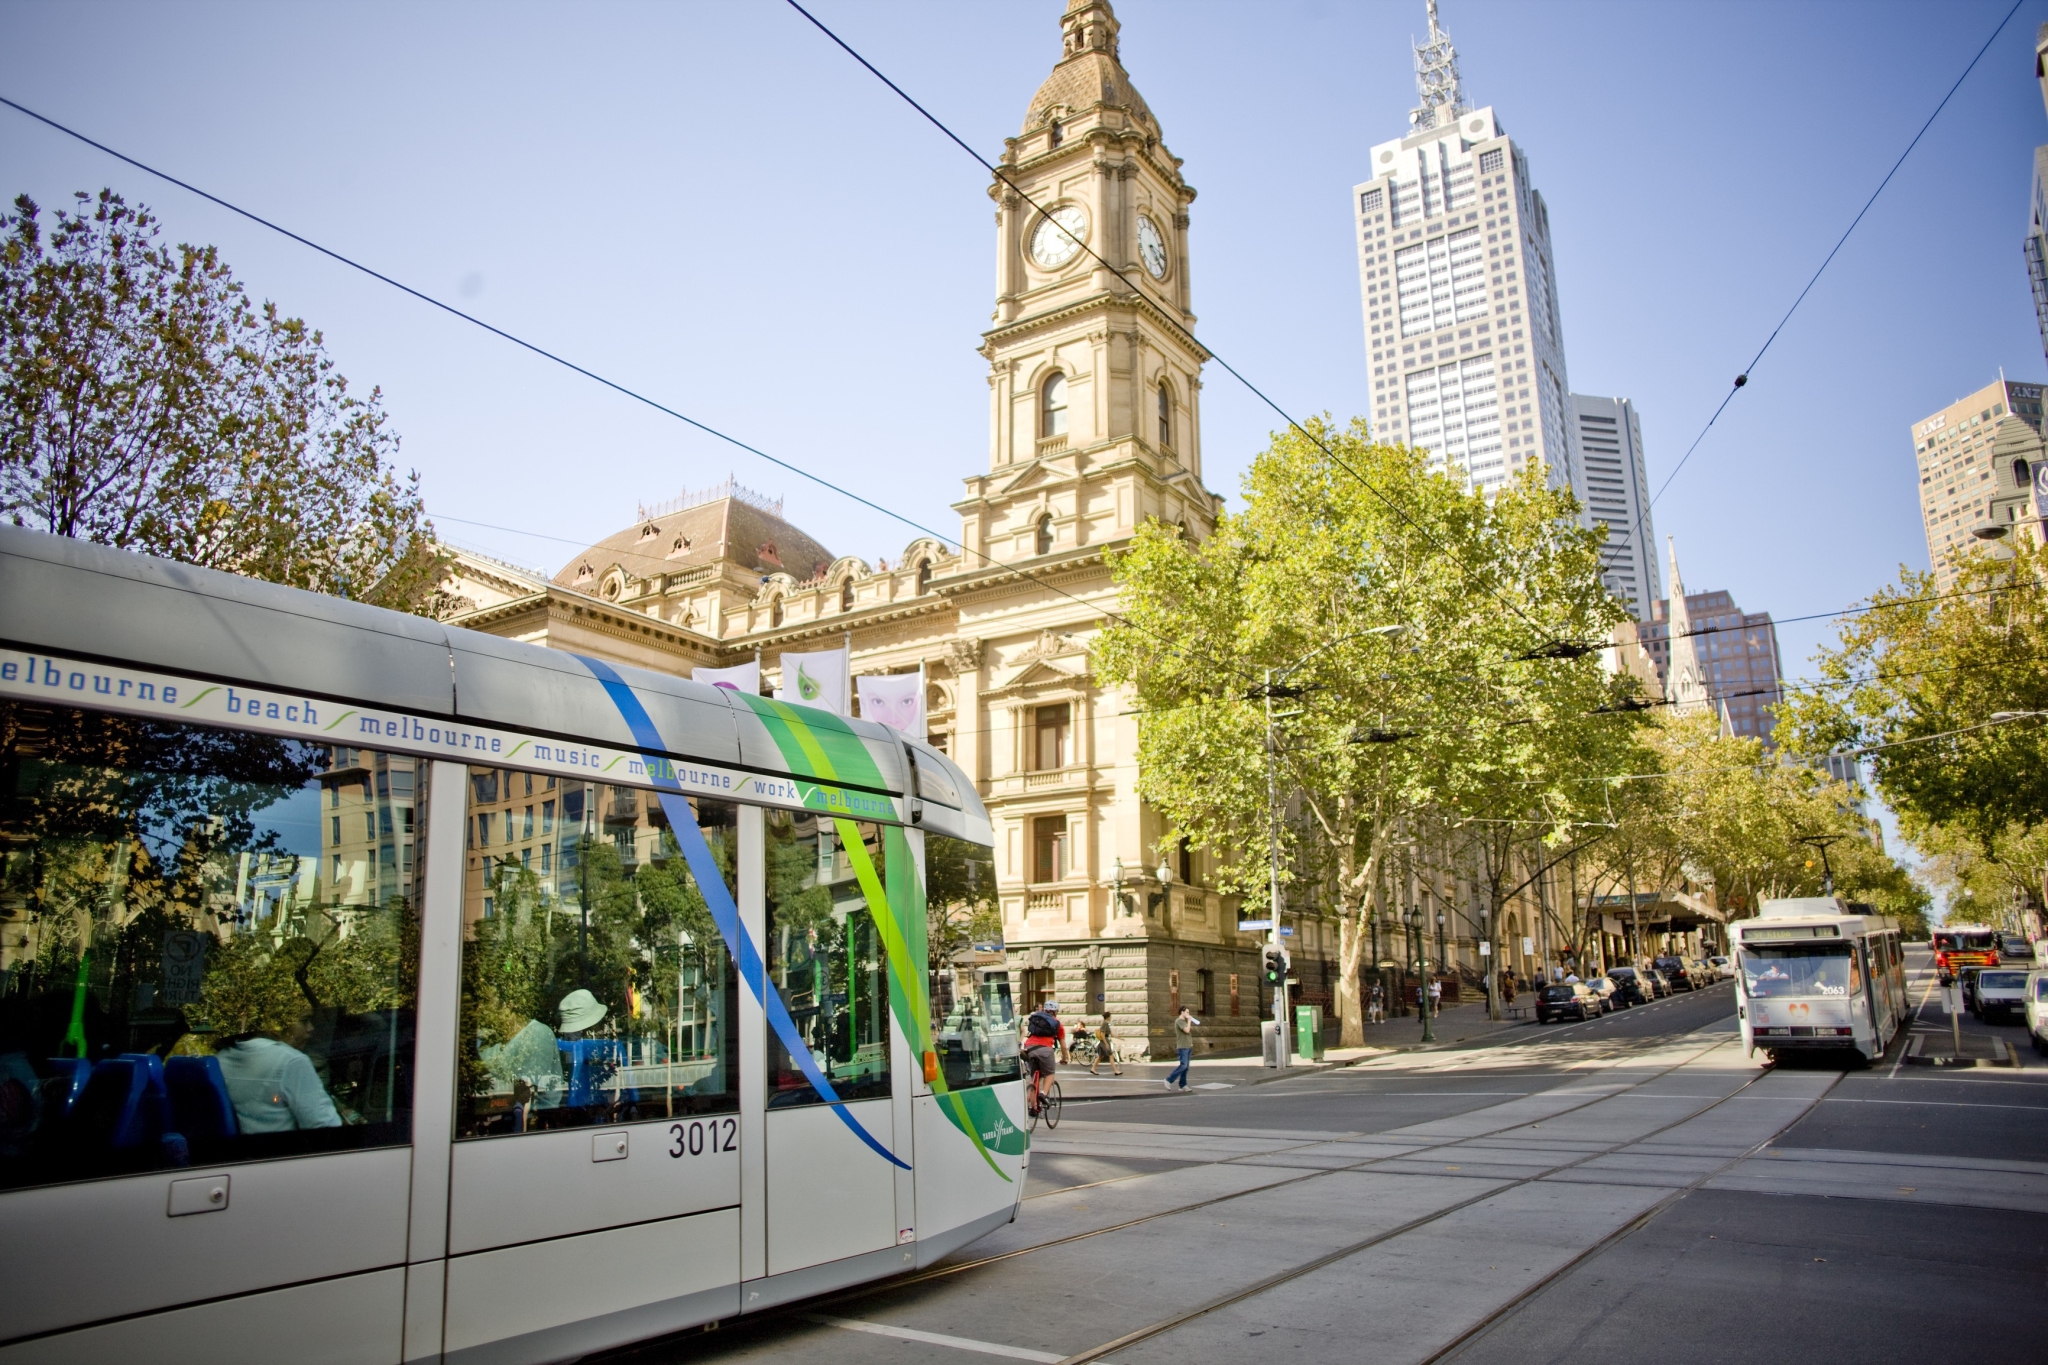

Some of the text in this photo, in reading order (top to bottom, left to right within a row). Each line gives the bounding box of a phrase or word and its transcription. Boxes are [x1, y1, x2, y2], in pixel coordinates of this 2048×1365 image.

[2011, 386, 2041, 399] ANZ
[1918, 414, 1946, 439] ANZ
[227, 688, 318, 725] beach
[360, 716, 501, 753] melbourne
[534, 744, 600, 768] music
[629, 759, 730, 789] melbourne
[754, 781, 795, 799] work
[816, 790, 894, 815] melbourne
[1819, 927, 1833, 936] 112
[1822, 986, 1845, 995] 2063
[669, 1118, 737, 1158] 3012
